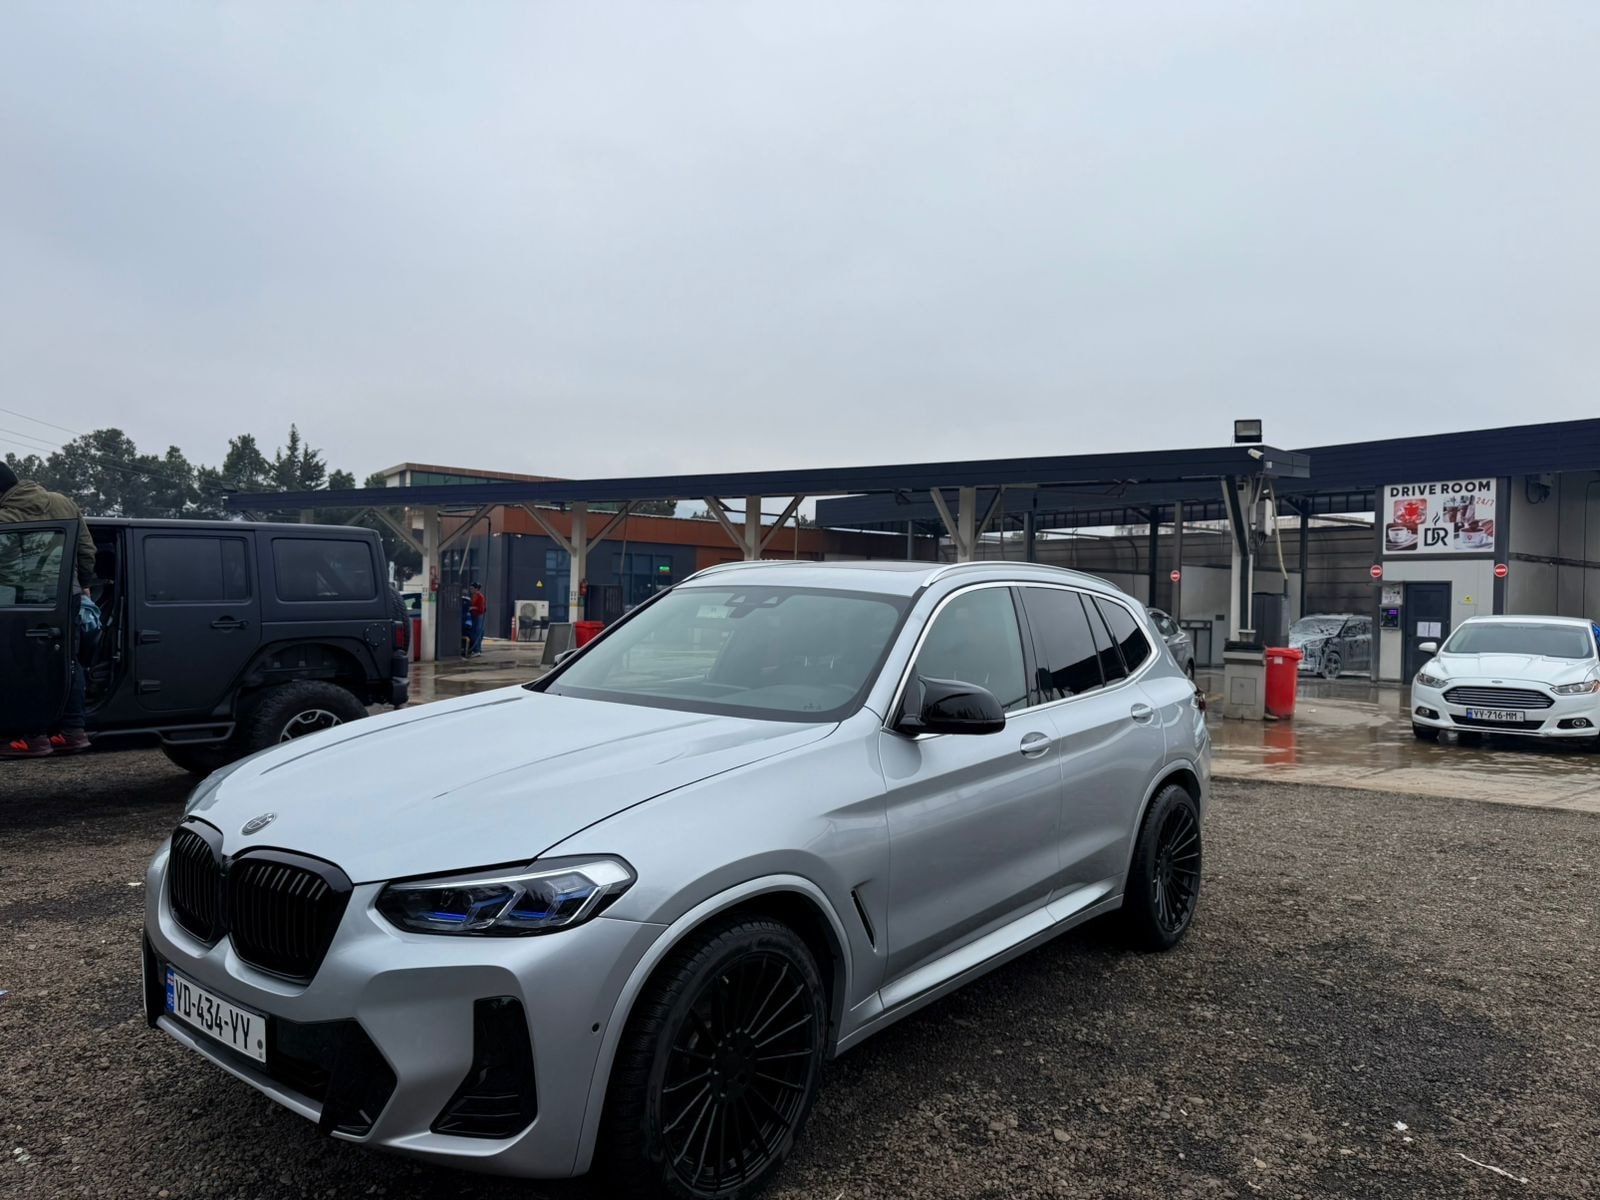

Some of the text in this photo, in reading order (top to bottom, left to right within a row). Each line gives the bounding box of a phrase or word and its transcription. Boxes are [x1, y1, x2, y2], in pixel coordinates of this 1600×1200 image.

[1390, 480, 1491, 498] DRIVE ROOM
[175, 978, 250, 1050] YD-434-YY
